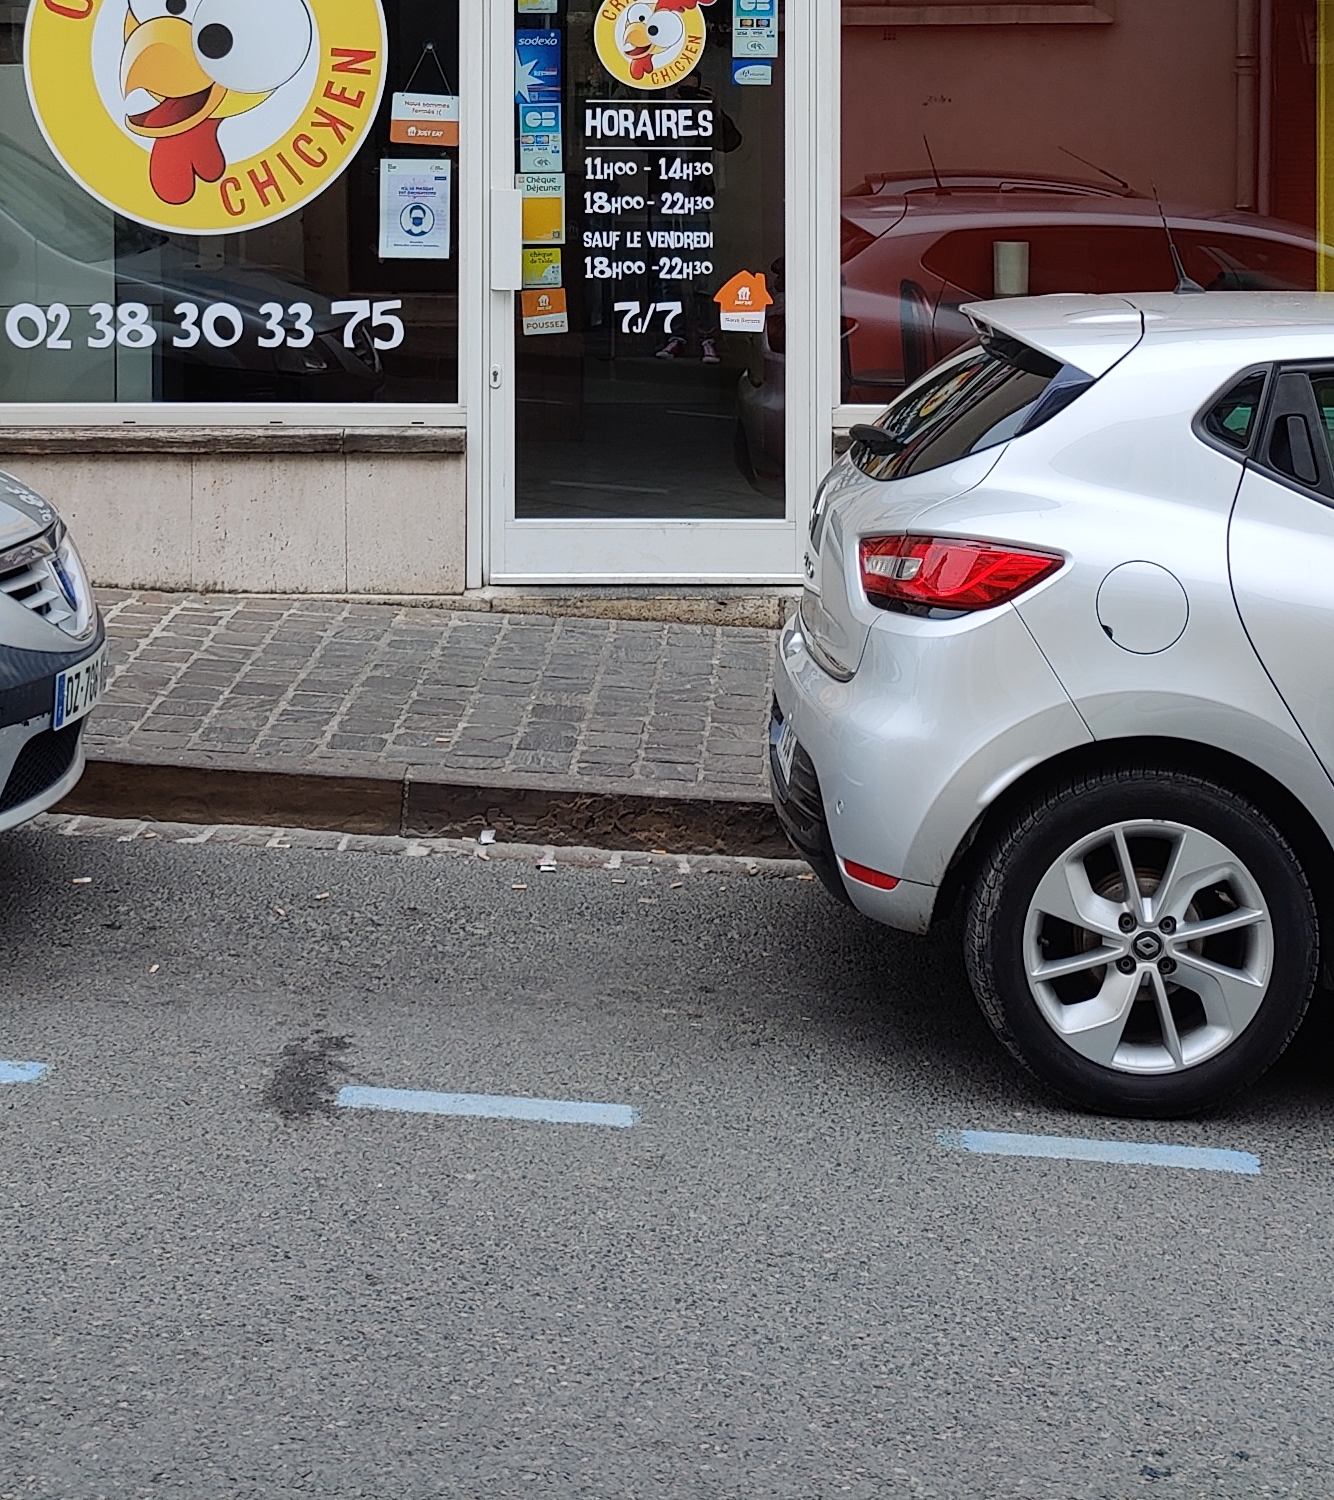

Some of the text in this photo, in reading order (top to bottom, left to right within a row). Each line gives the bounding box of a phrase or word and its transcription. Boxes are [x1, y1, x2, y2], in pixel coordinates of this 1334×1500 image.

[518, 35, 558, 46] sodexo
[651, 34, 703, 85] CHICKEN
[219, 46, 378, 218] CHICKEN
[585, 107, 713, 141] HORAIRES
[584, 157, 637, 181] 11H00
[658, 157, 714, 181] 14H30
[583, 231, 713, 250] SAUF LE VENDREDI
[5, 299, 405, 350] 02 38 30 33 75
[526, 320, 565, 330] POUSSEZ
